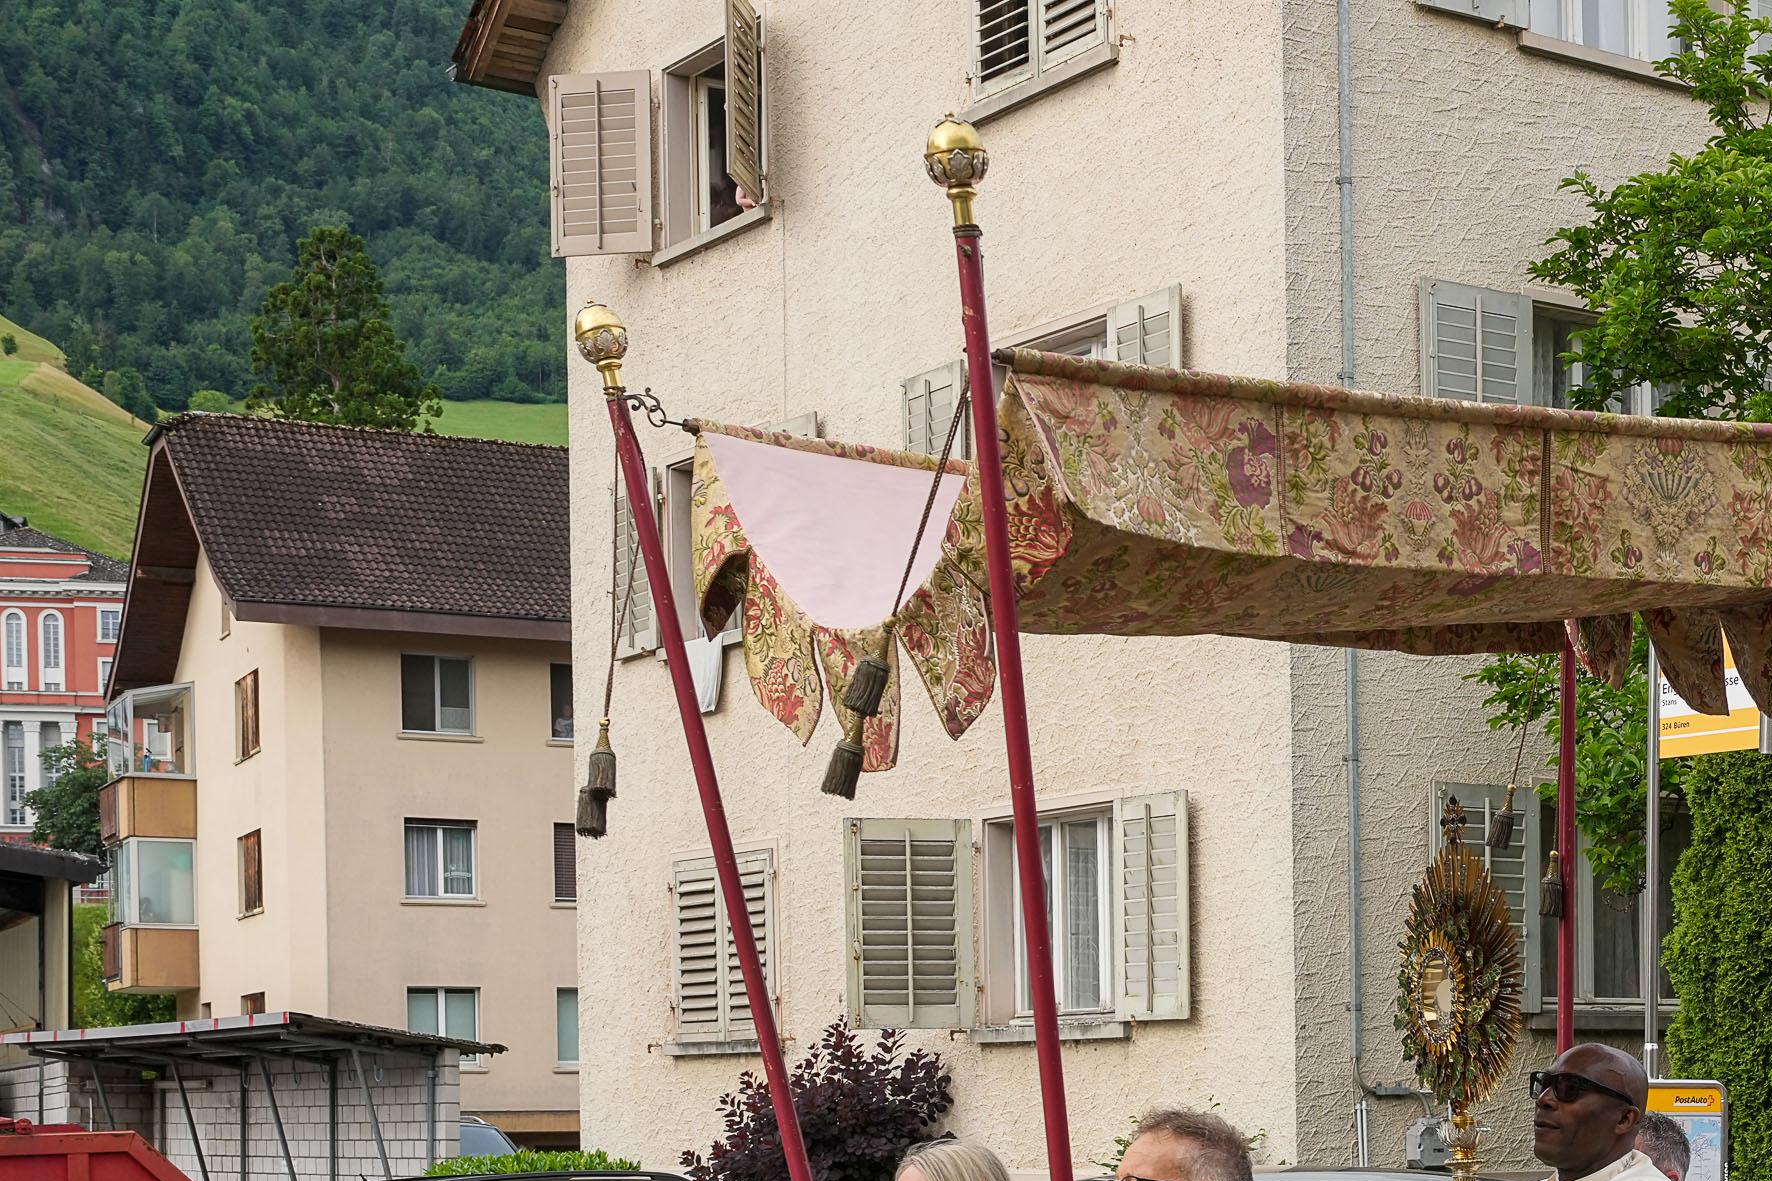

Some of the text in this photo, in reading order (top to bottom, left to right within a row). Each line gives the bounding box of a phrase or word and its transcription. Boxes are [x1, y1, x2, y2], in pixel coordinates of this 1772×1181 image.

[1662, 721, 1690, 730] 324 Büren
[1675, 1095, 1708, 1104] PostAuto
